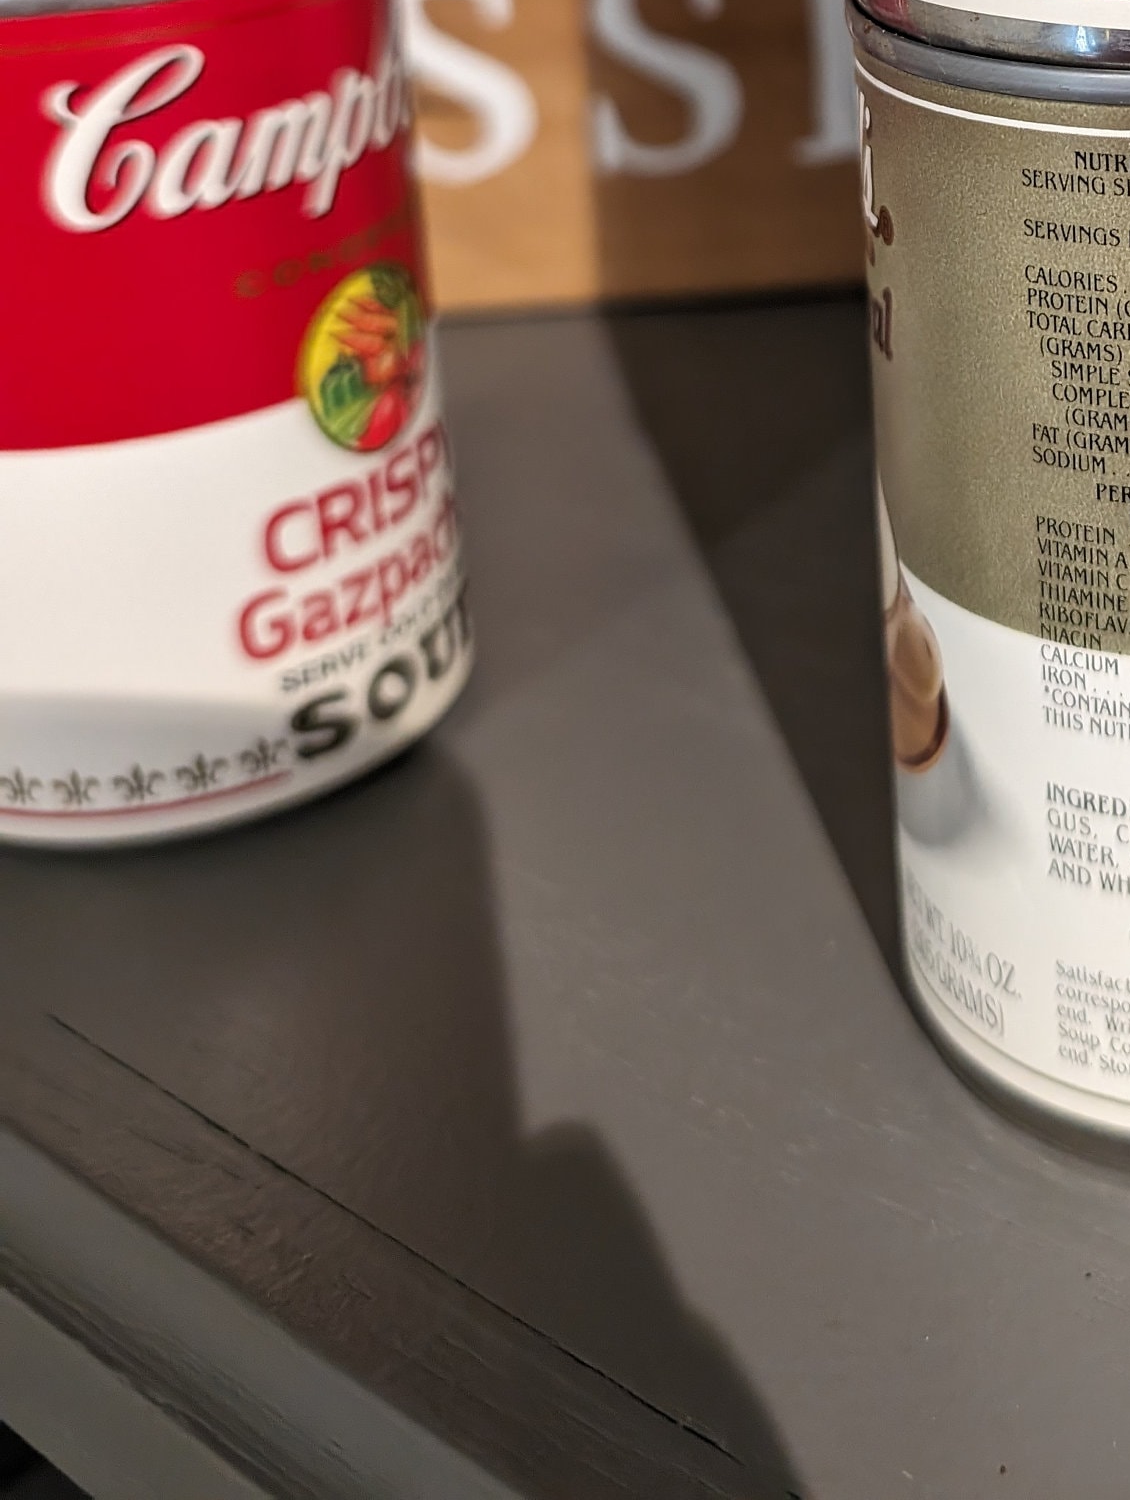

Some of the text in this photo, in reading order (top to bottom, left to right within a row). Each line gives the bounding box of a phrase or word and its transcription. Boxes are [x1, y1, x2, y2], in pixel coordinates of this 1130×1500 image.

[1022, 168, 1105, 197] SERVING
[1022, 219, 1121, 248] SERVINGS
[1024, 265, 1118, 293] CALORIES
[1026, 311, 1082, 337] TOTAL
